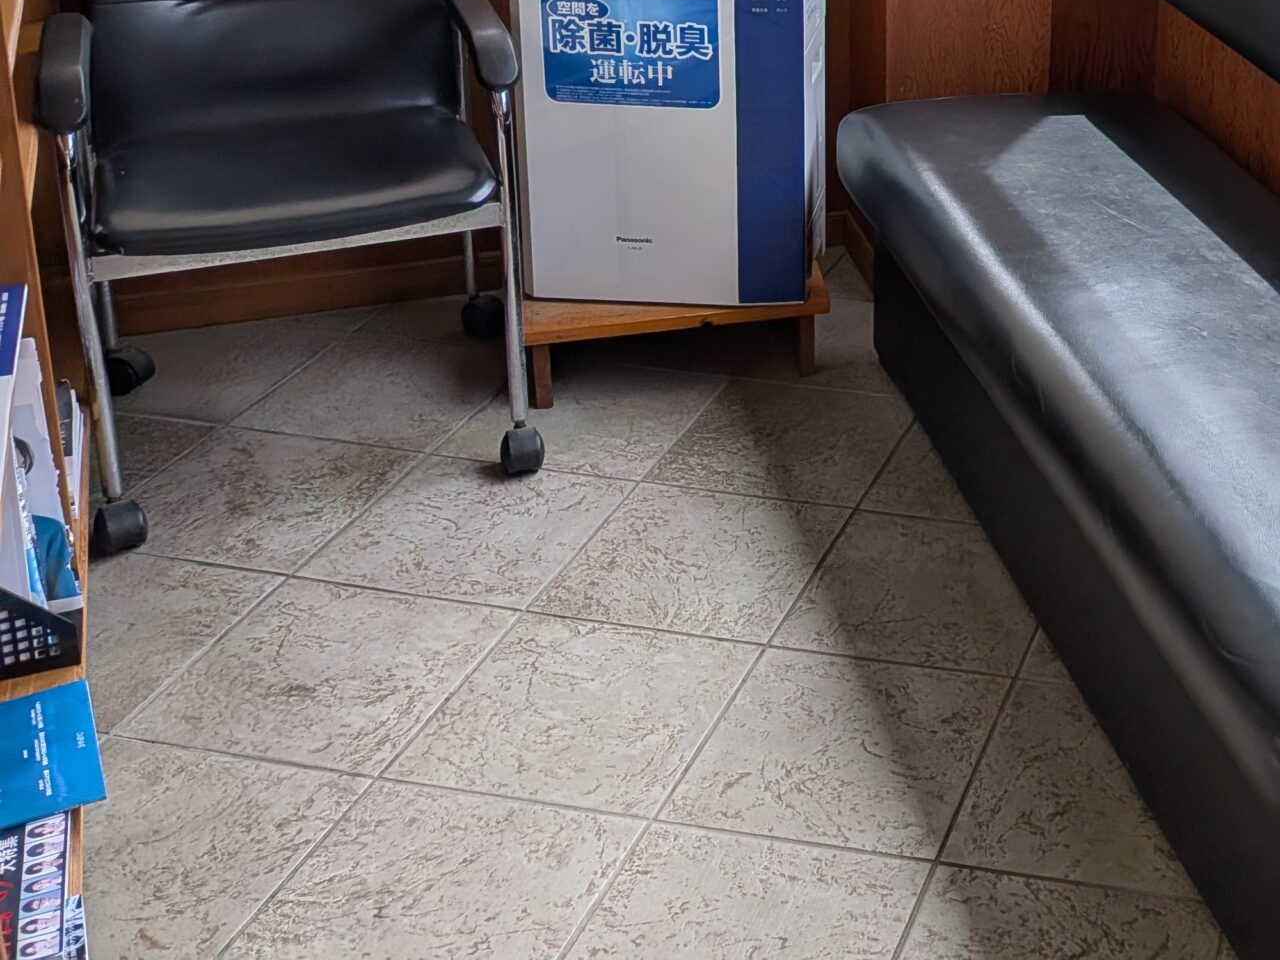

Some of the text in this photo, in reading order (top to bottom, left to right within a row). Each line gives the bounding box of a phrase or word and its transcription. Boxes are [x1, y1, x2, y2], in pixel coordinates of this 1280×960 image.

[556, 1, 599, 15] 空間を
[550, 16, 713, 59] 除菌・脱臭
[589, 58, 674, 87] 運転中
